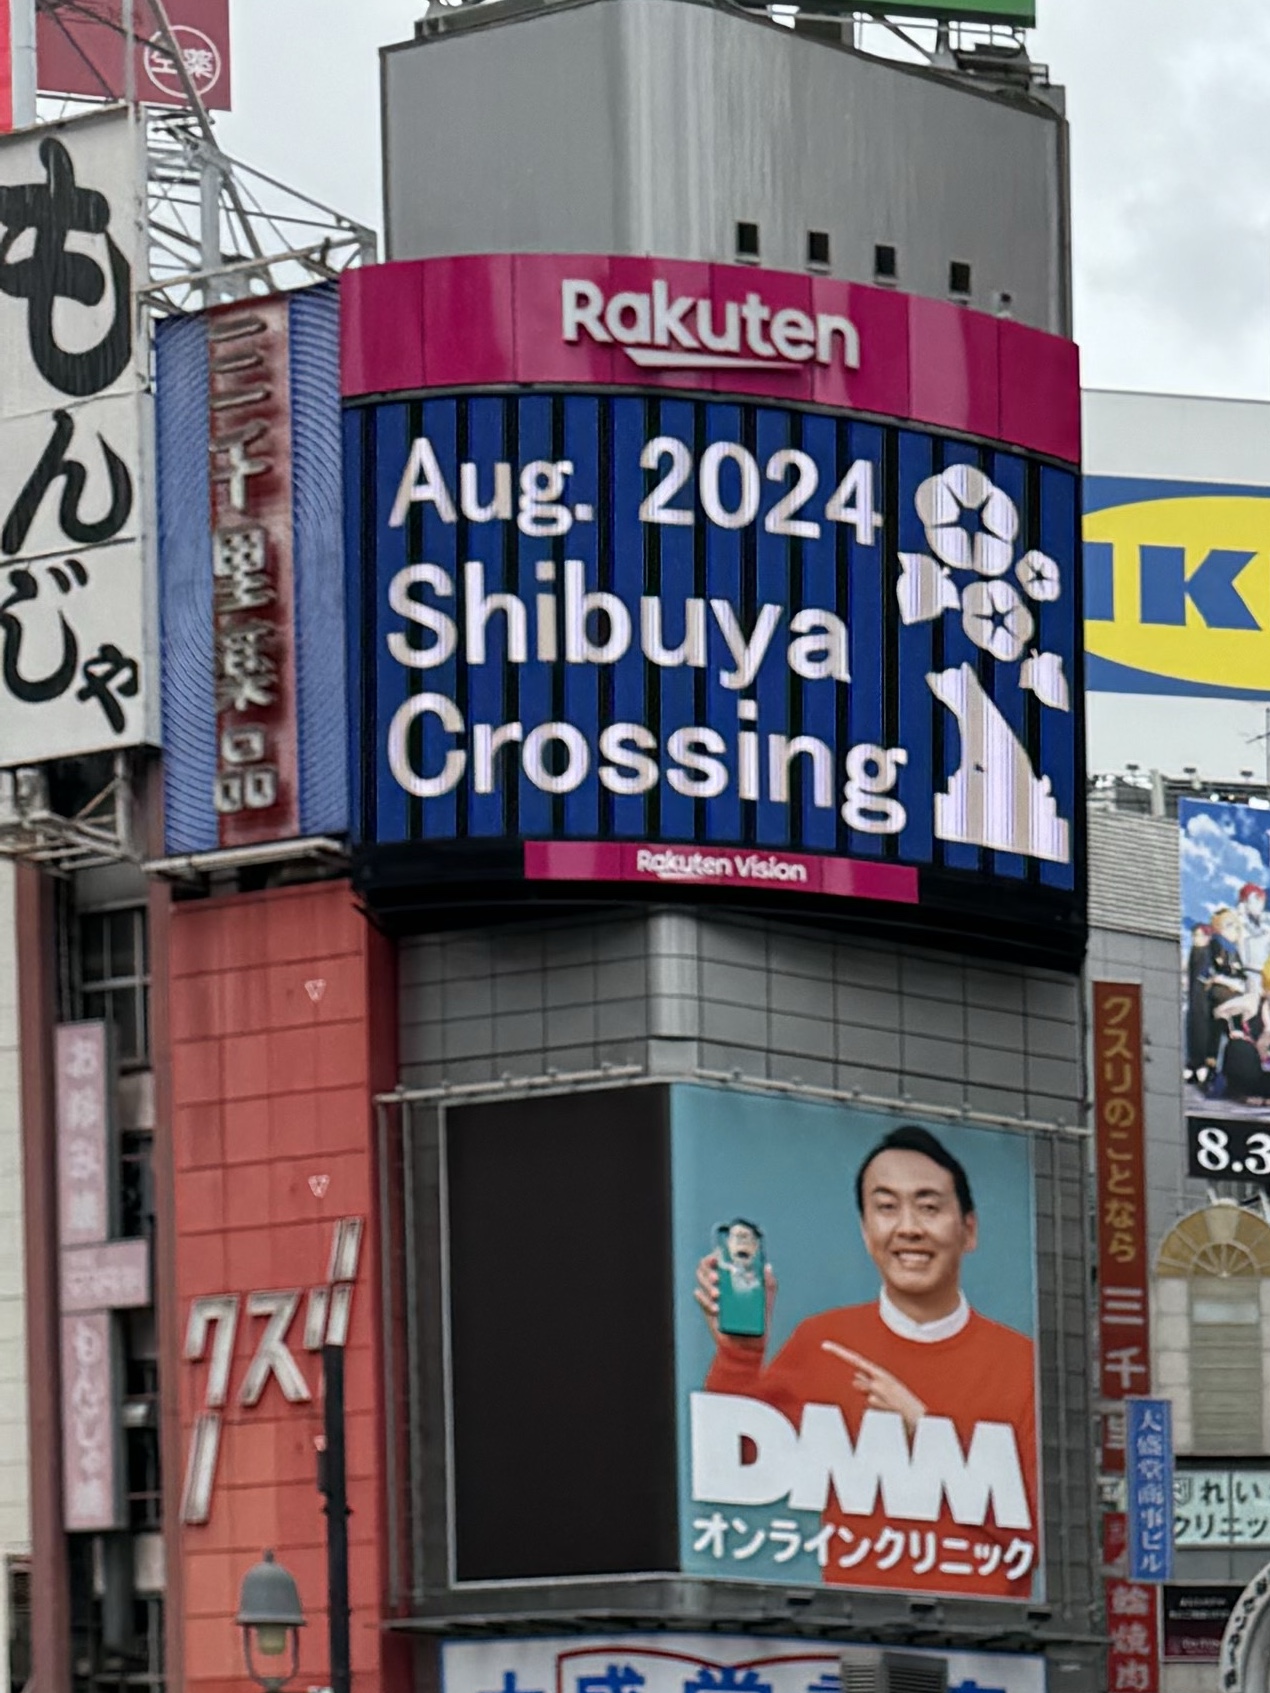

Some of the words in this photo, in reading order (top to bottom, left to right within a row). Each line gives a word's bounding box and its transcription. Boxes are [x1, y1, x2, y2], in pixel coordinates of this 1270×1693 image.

[561, 278, 860, 369] Rakuten
[0, 137, 139, 735] もんじゃ
[388, 436, 594, 537] Aug.
[639, 436, 883, 546] 2024
[210, 313, 276, 813] 三千里薬品
[387, 560, 851, 691] Shibuya
[387, 692, 908, 835] Crossing
[637, 848, 732, 880] Rakuten
[735, 854, 807, 883] Vision
[1102, 995, 1137, 1266] クスリのことなら
[690, 1392, 1033, 1531] DMM
[693, 1514, 1035, 1581] オンラインクリニック
